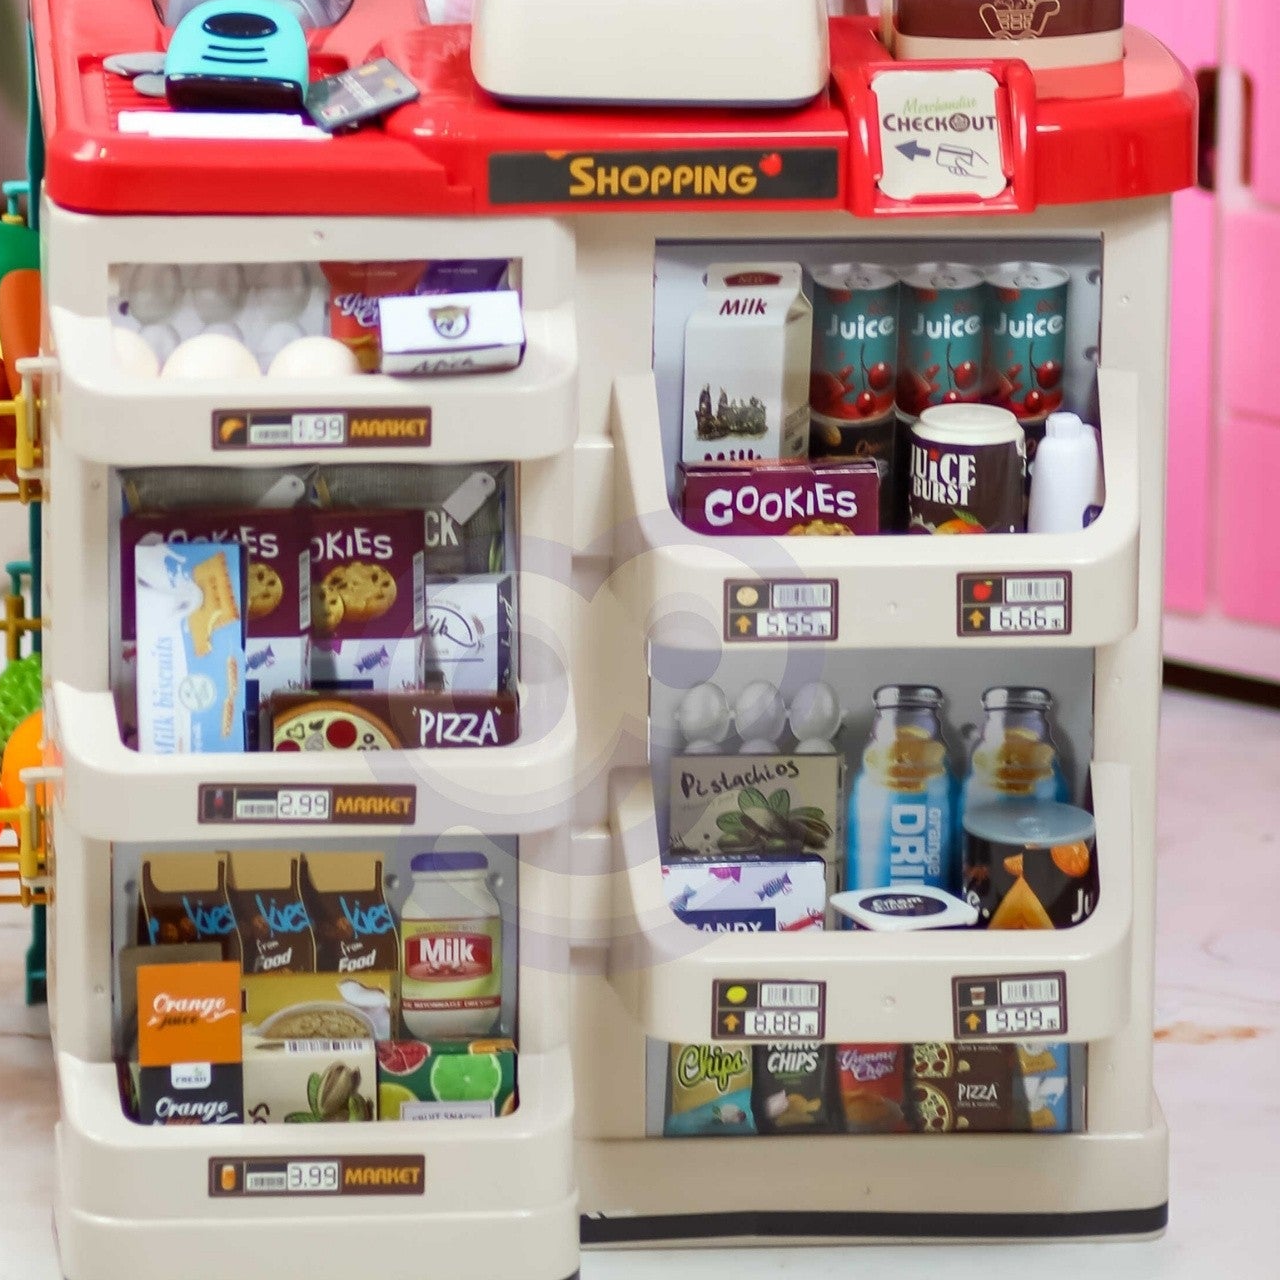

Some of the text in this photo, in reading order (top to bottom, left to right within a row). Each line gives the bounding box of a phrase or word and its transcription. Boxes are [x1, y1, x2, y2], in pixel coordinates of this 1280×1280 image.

[882, 112, 997, 133] CHECKOUT
[569, 156, 758, 196] SHOPPING
[718, 297, 768, 316] Milk
[825, 313, 895, 341] Juice
[911, 312, 982, 340] Juice
[994, 312, 1065, 339] Juice
[298, 417, 429, 440] 1.99 MARKET
[913, 475, 972, 506] BURST
[704, 482, 859, 527] COOKIES
[766, 612, 814, 635] 5.55
[999, 606, 1048, 631] 6.66
[680, 760, 800, 799] Pistachios
[279, 794, 414, 816] 2.99 MARKET
[692, 921, 763, 932] ANDY
[338, 948, 377, 972] Food
[419, 937, 475, 970] Milk
[152, 992, 227, 1019] Orange
[753, 1011, 802, 1036] 8.88
[995, 1007, 1043, 1033] 9.99
[767, 1052, 820, 1073] CHIPS
[957, 1083, 998, 1101] PIZZA
[155, 1096, 229, 1122] Orange
[290, 1165, 421, 1188] 3.99 MARKET
